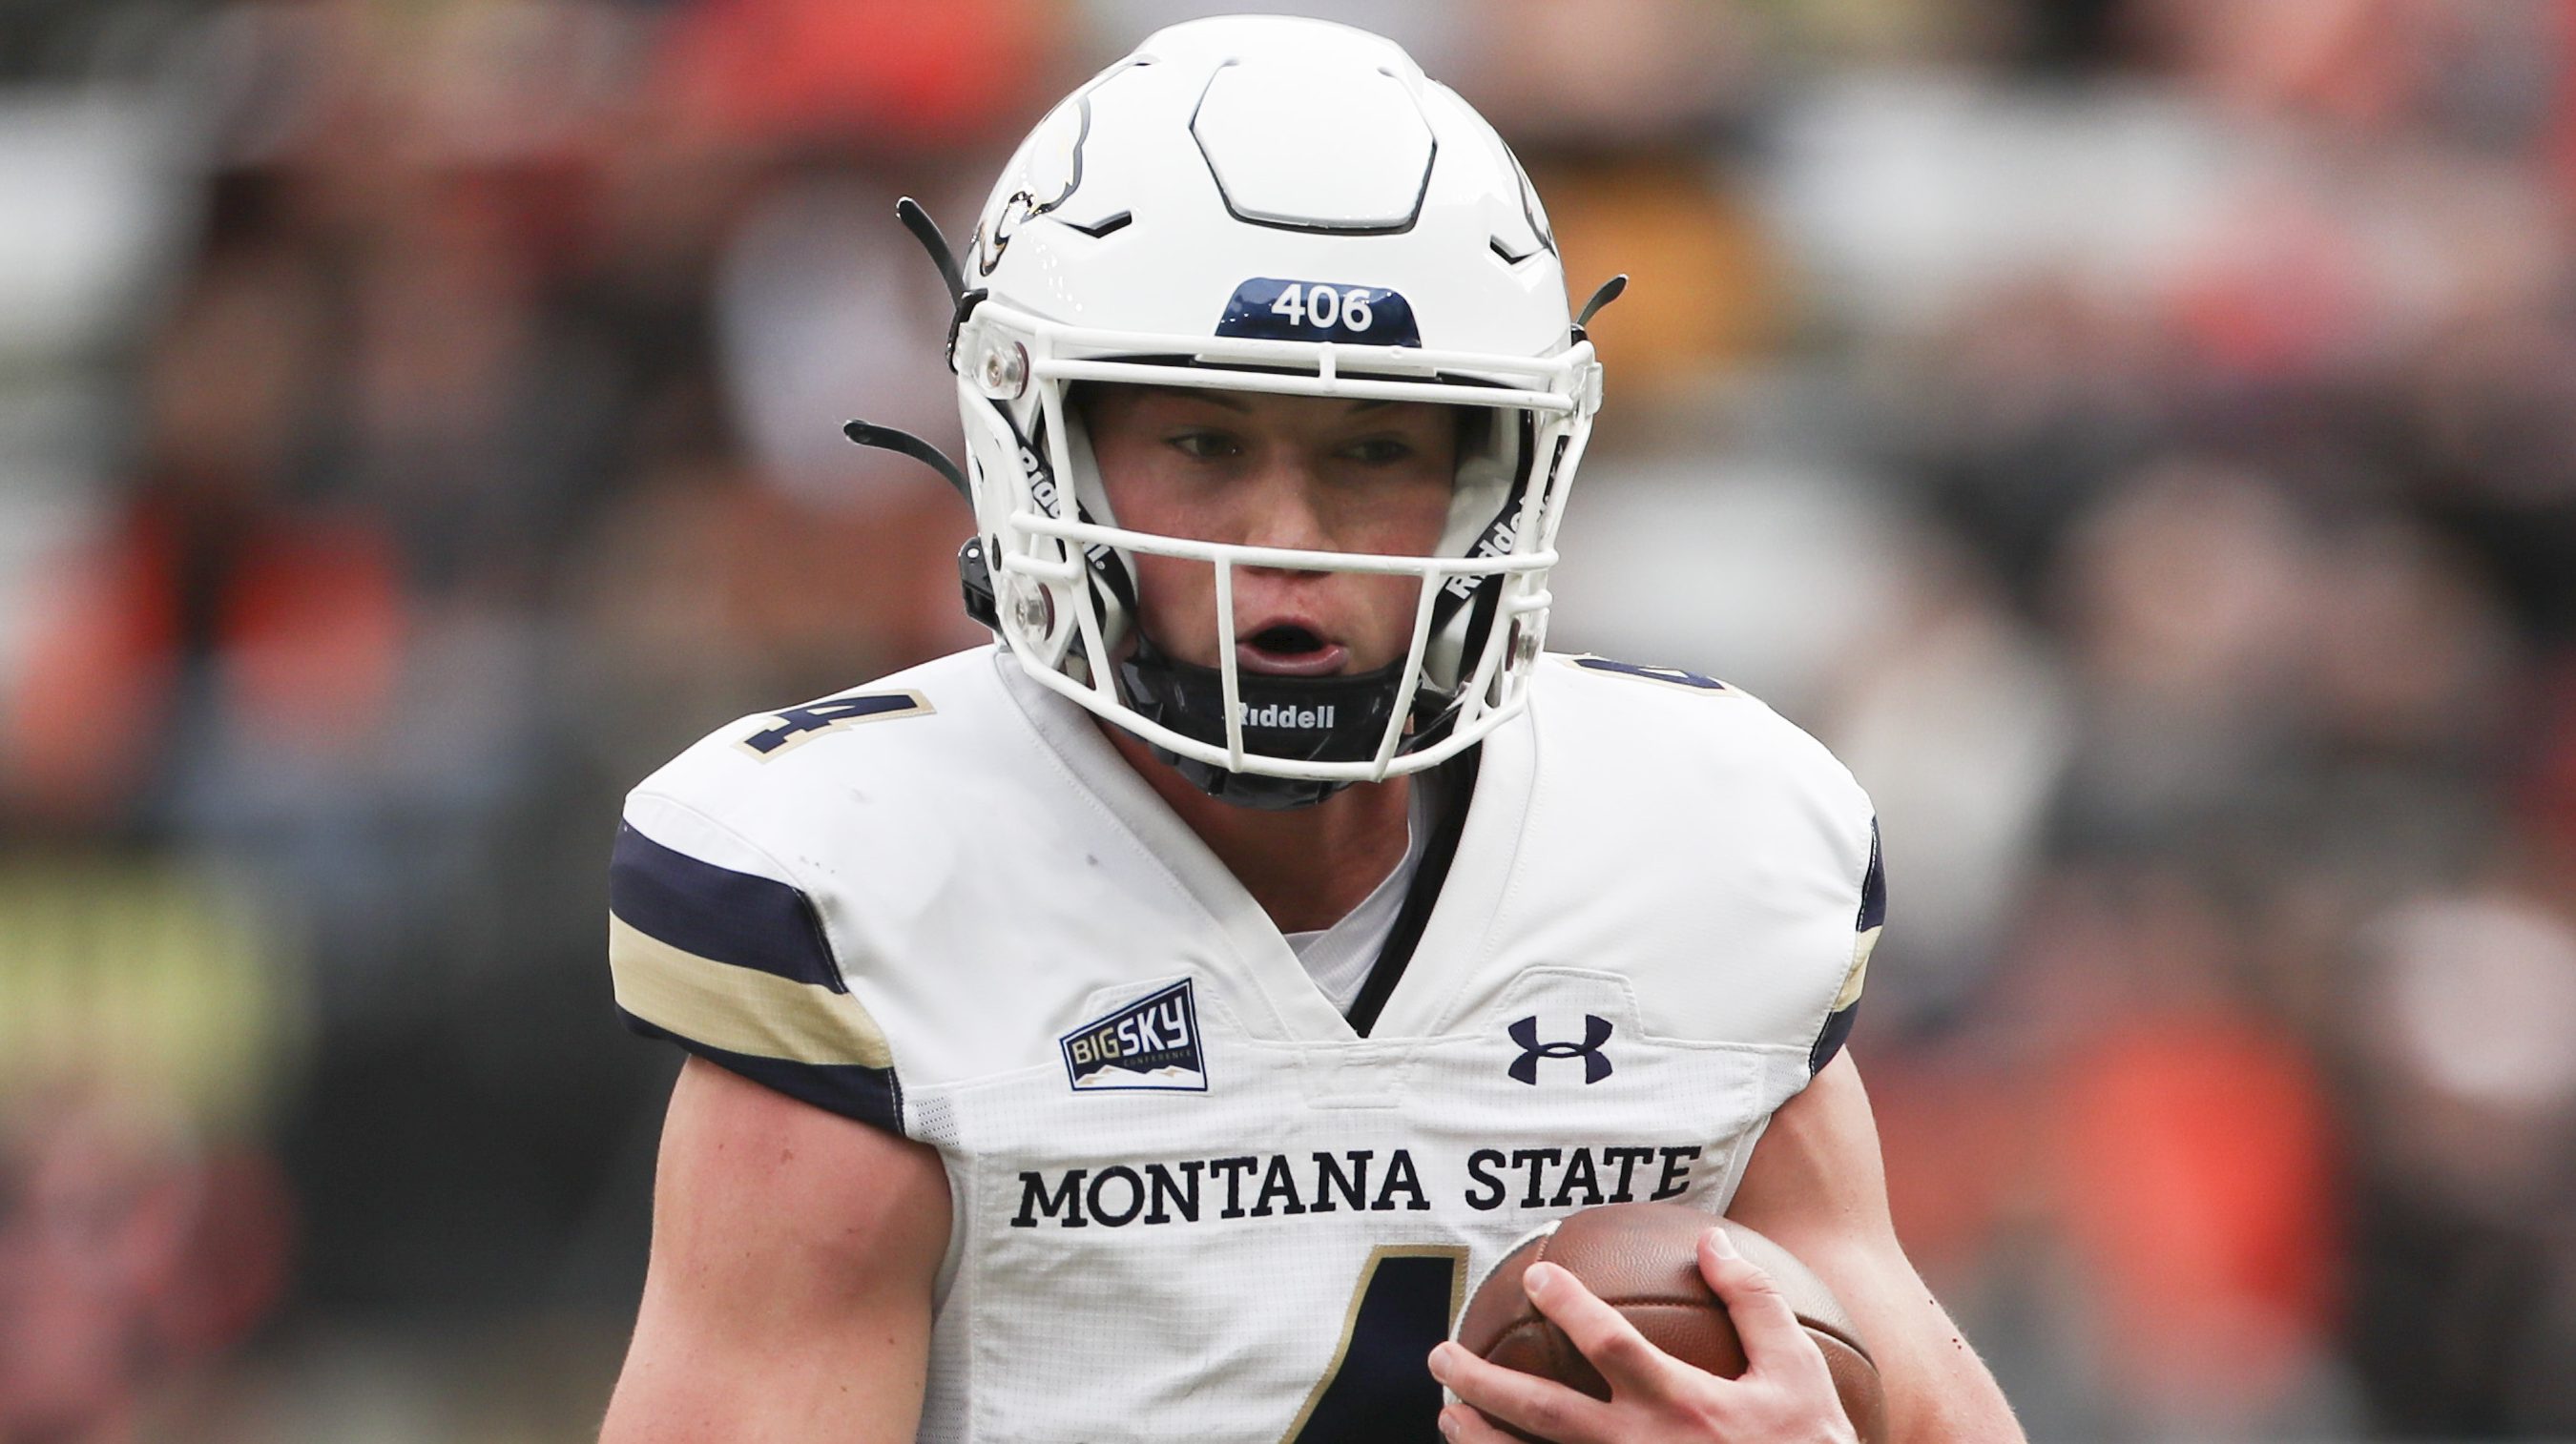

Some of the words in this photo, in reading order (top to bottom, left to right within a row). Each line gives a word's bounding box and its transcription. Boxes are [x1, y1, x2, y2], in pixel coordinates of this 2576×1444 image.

[1271, 283, 1373, 332] 406
[730, 689, 938, 764] 4
[1011, 1150, 1430, 1228] MONTANA
[1465, 1146, 1701, 1210] STATE
